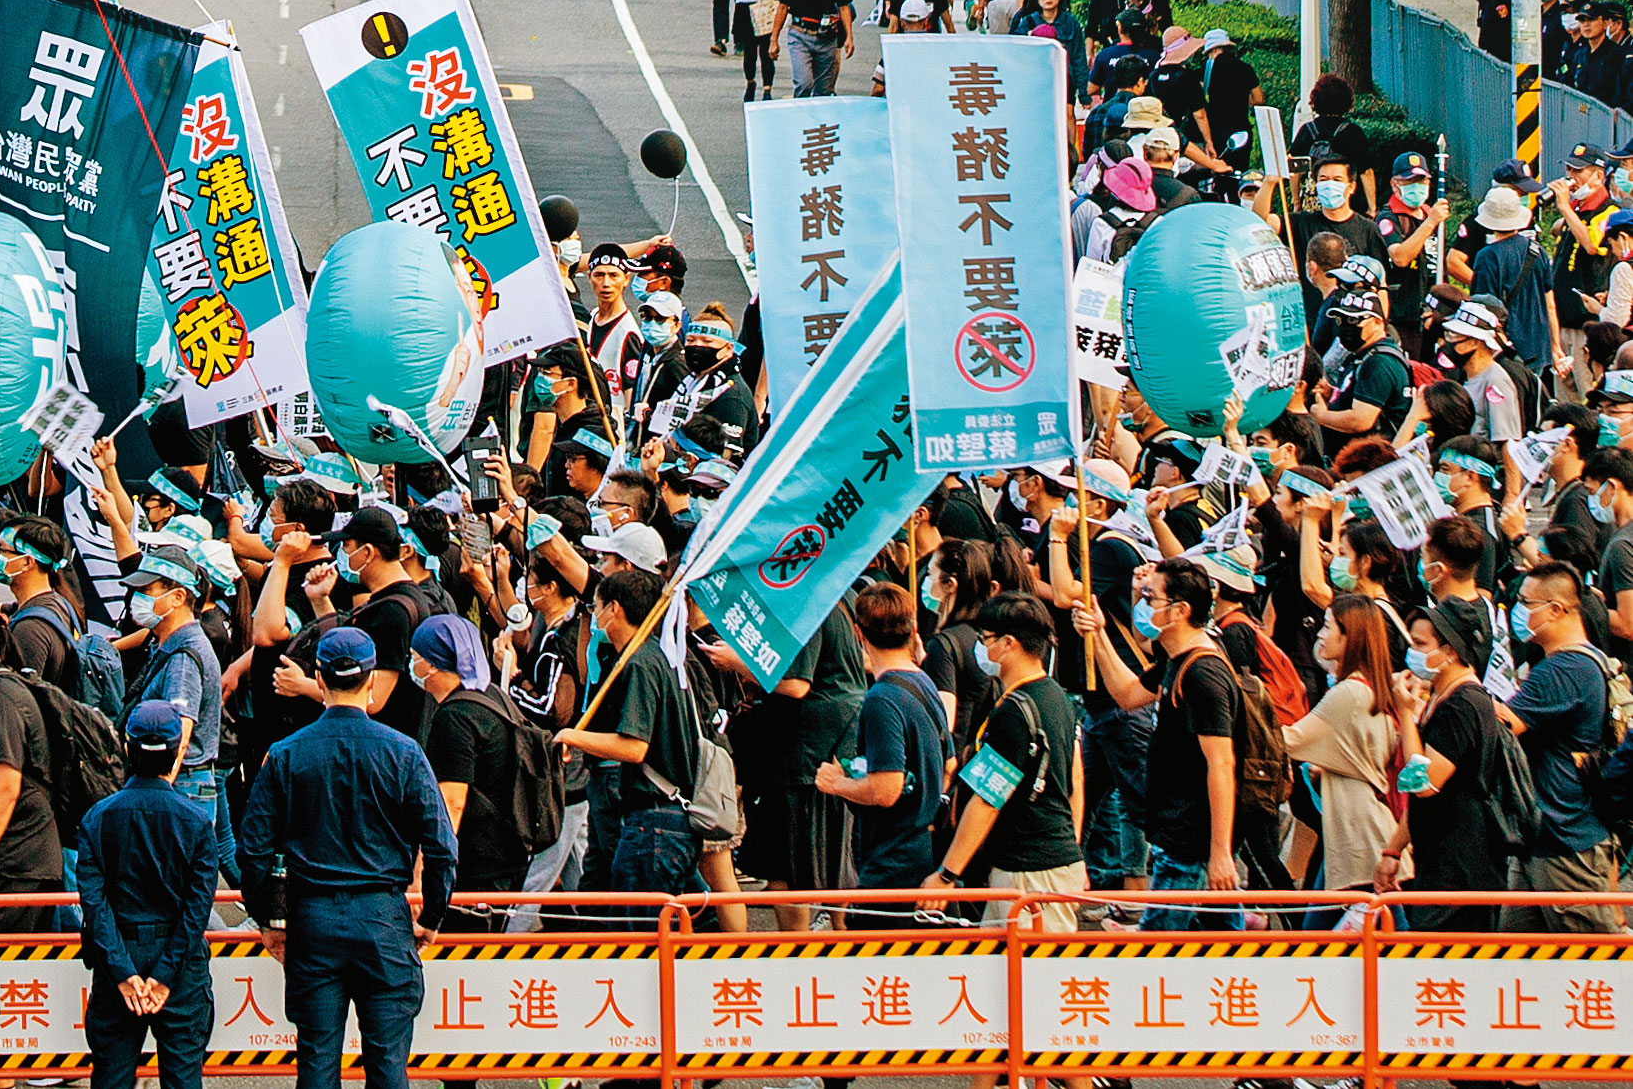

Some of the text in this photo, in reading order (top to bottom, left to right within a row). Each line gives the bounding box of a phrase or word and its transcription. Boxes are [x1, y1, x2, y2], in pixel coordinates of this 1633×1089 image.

[20, 30, 106, 140] 眾
[407, 47, 518, 243] 沒溝通
[180, 93, 274, 291] 沒溝通
[721, 601, 782, 677] 蔡壁如
[711, 974, 989, 1029] 禁止進入
[1059, 975, 1337, 1029] 禁止進入
[1414, 977, 1617, 1031] 禁止進
[248, 1034, 298, 1046] 107-240
[608, 1035, 657, 1048] 107-243
[1308, 1032, 1359, 1046] 107-367
